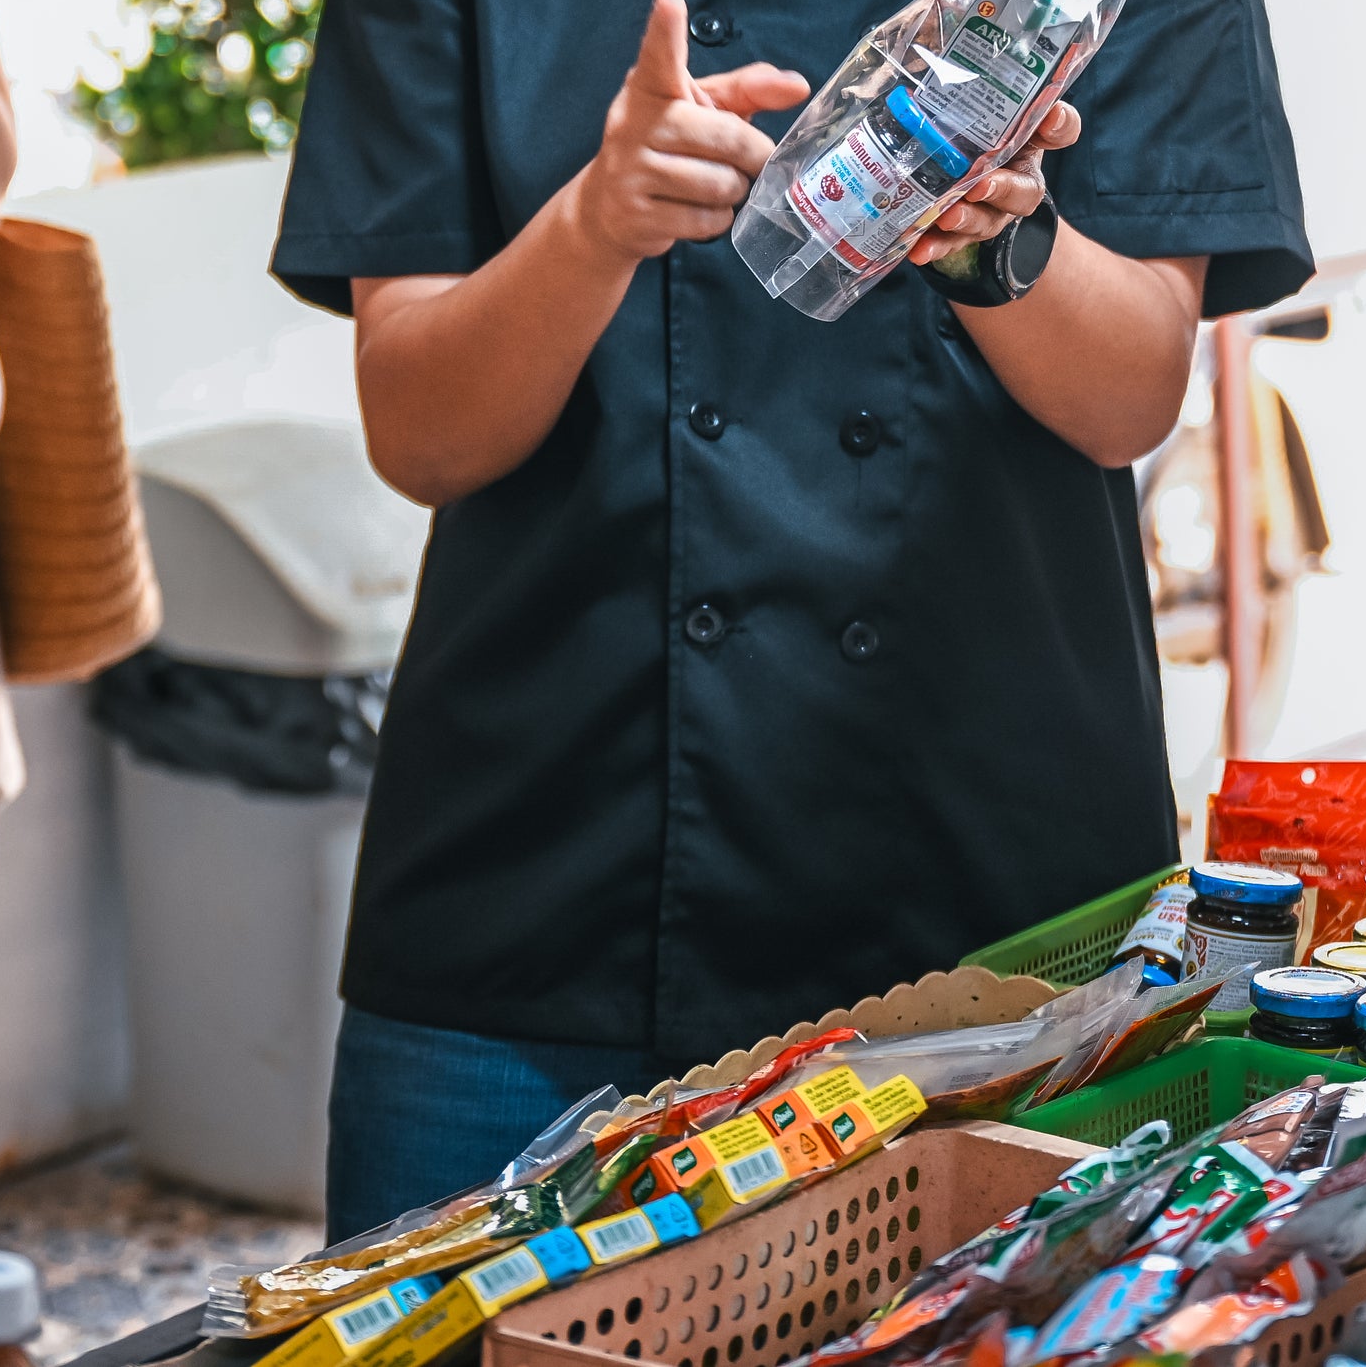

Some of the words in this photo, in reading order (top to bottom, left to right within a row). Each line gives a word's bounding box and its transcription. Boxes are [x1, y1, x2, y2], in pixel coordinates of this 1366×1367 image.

[974, 23, 1038, 69] AROD
[834, 166, 848, 183] CHILI
[846, 181, 866, 201] PASTE
